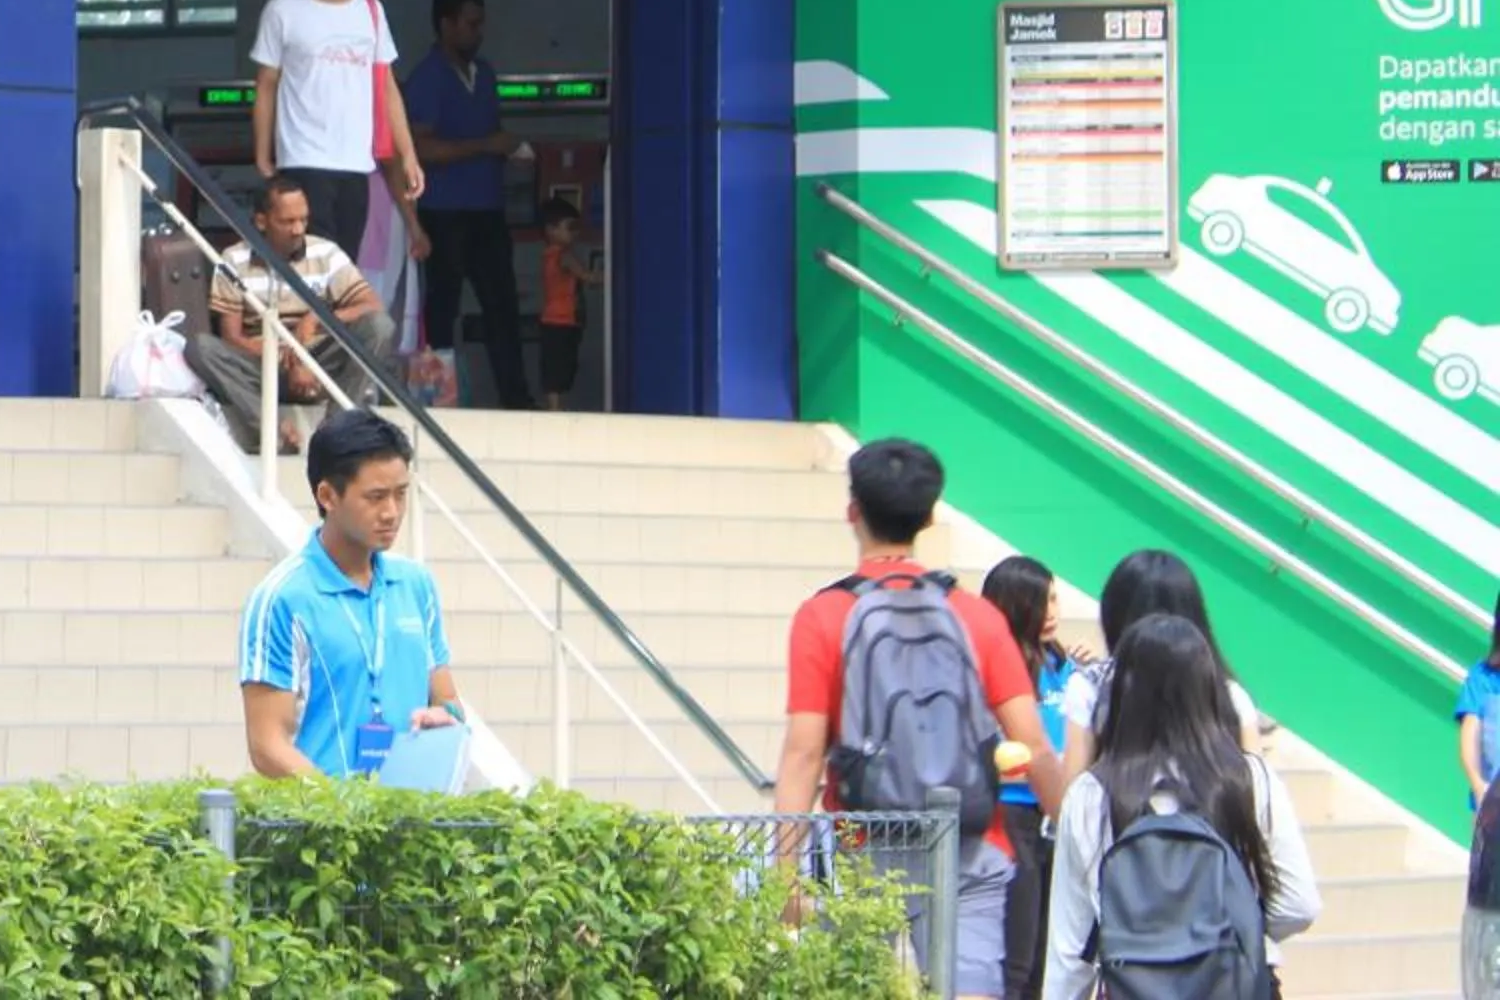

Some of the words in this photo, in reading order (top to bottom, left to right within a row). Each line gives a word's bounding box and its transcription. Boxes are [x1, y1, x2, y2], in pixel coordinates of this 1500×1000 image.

[1009, 12, 1055, 30] Masjid
[1009, 27, 1057, 41] Jamek
[1379, 115, 1476, 146] dengan
